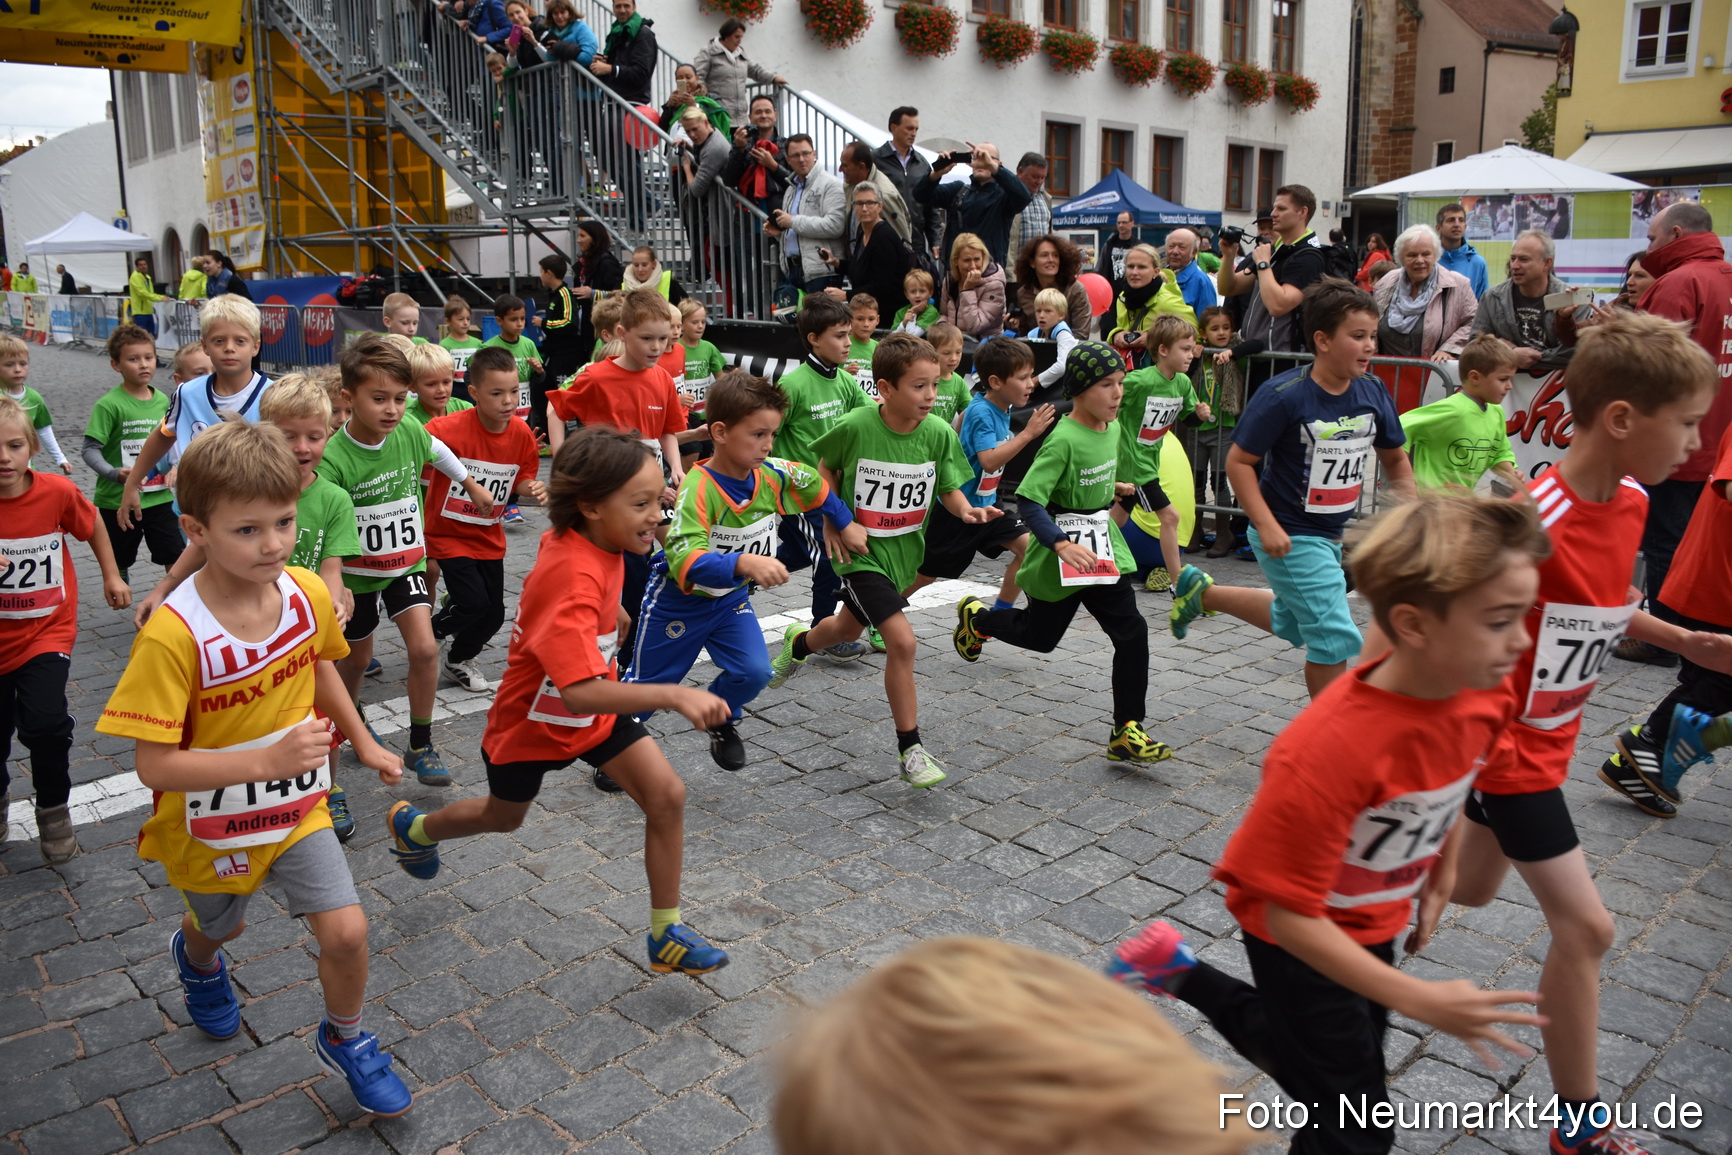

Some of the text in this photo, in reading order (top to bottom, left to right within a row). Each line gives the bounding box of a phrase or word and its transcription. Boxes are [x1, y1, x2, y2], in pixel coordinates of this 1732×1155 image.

[90, 2, 211, 20] Neumarkter Stadtlauf
[55, 38, 165, 51] Neumarkter Stadtlauf
[122, 418, 159, 427] Neumarkter
[122, 426, 152, 435] Stadtlauf
[1316, 447, 1342, 455] PARTL
[482, 468, 509, 477] Neumarkt
[859, 465, 925, 480] PARTL Neumarkt
[864, 478, 928, 510] 7193
[369, 508, 408, 521] Neumarkt
[877, 515, 907, 528] Jakob
[1058, 517, 1086, 527] PARTL
[711, 525, 768, 542] PARTL Neumarkt
[2, 544, 48, 556] Neumarkt
[362, 555, 406, 568] Lennart
[1545, 615, 1596, 633] PARTL
[200, 644, 320, 713] MAX BÖGL
[225, 808, 301, 835] Andreas
